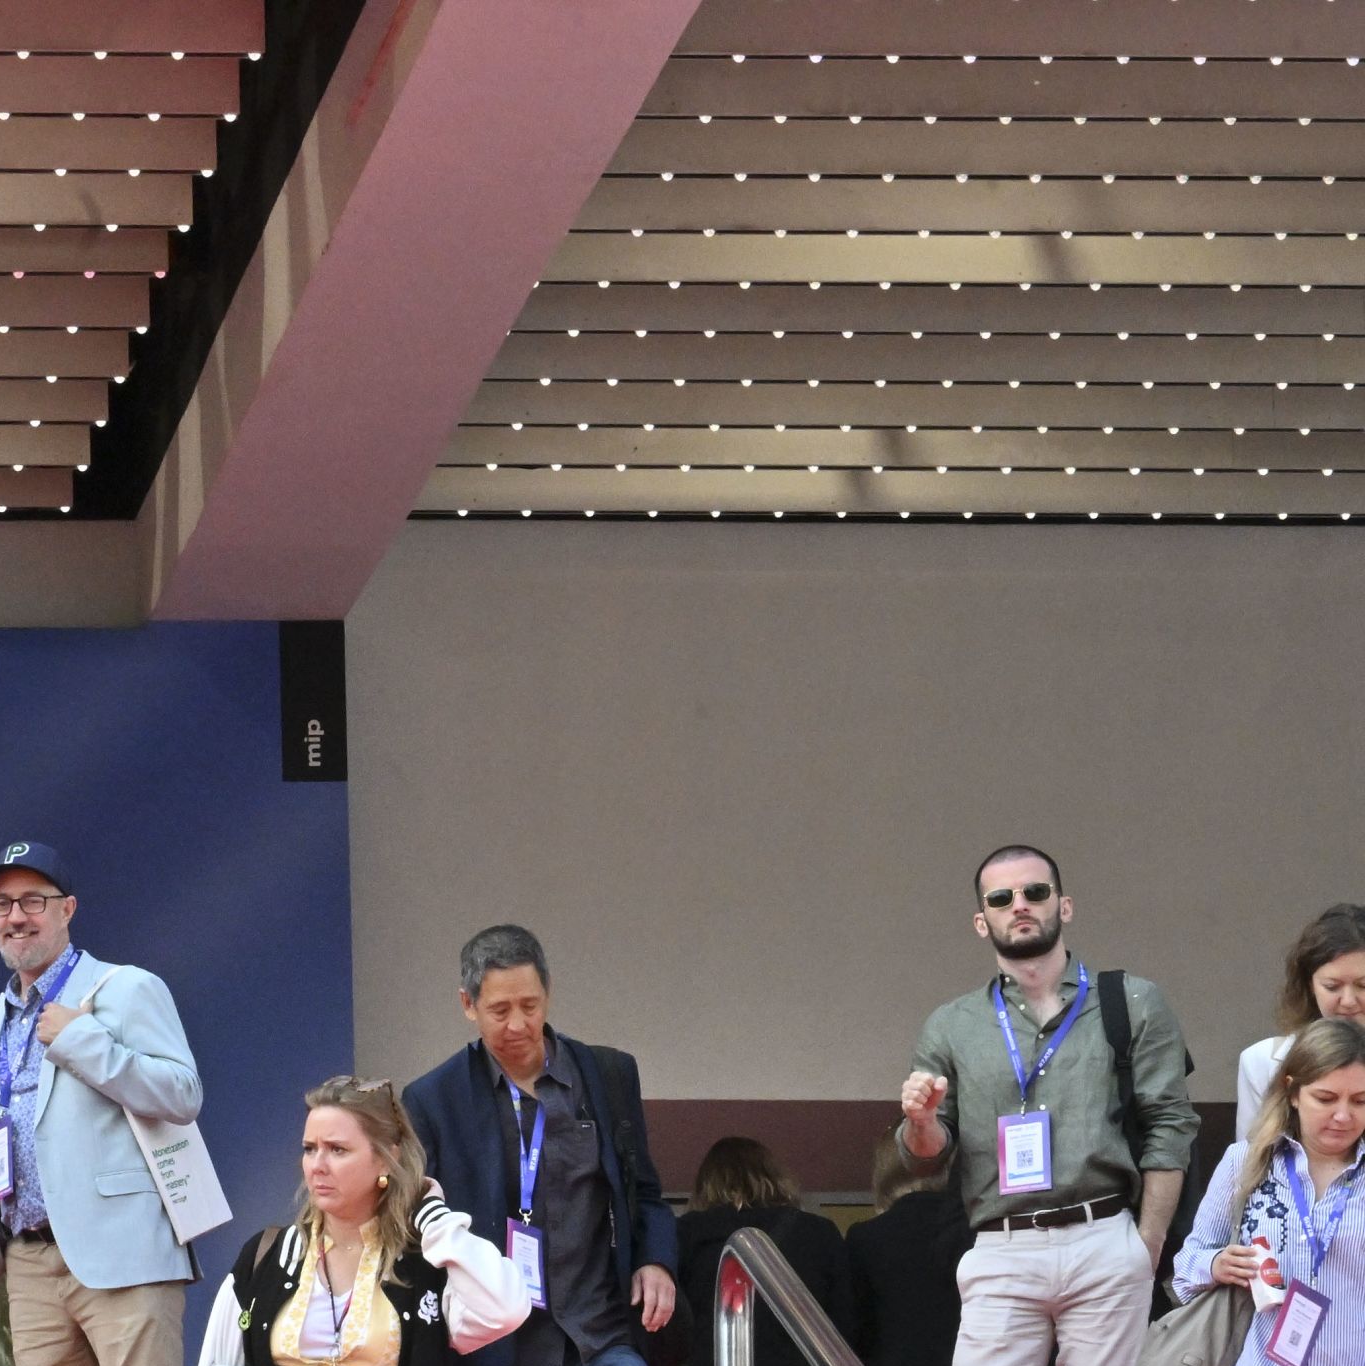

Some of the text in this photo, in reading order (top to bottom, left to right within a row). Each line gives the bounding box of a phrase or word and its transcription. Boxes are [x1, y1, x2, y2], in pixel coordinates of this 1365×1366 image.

[304, 719, 325, 767] mip
[4, 841, 30, 865] P
[152, 1139, 189, 1159] Monetization
[156, 1158, 175, 1169] comes
[161, 1169, 175, 1179] from
